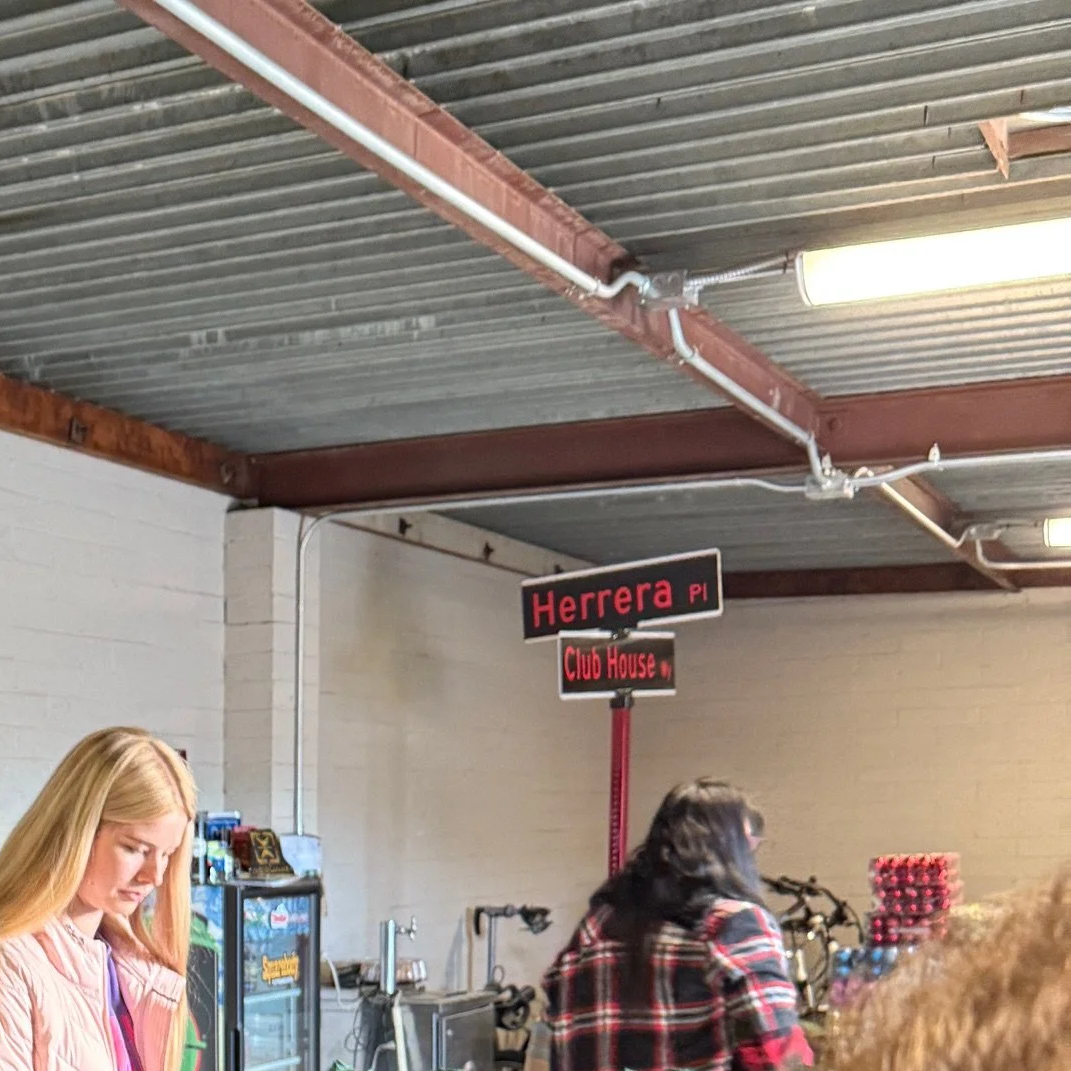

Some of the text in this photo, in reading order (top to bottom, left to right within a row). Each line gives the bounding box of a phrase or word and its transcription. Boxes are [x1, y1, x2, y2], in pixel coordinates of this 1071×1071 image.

[533, 580, 708, 628] Herrera Pl
[564, 646, 601, 681] Club
[606, 647, 656, 679] House
